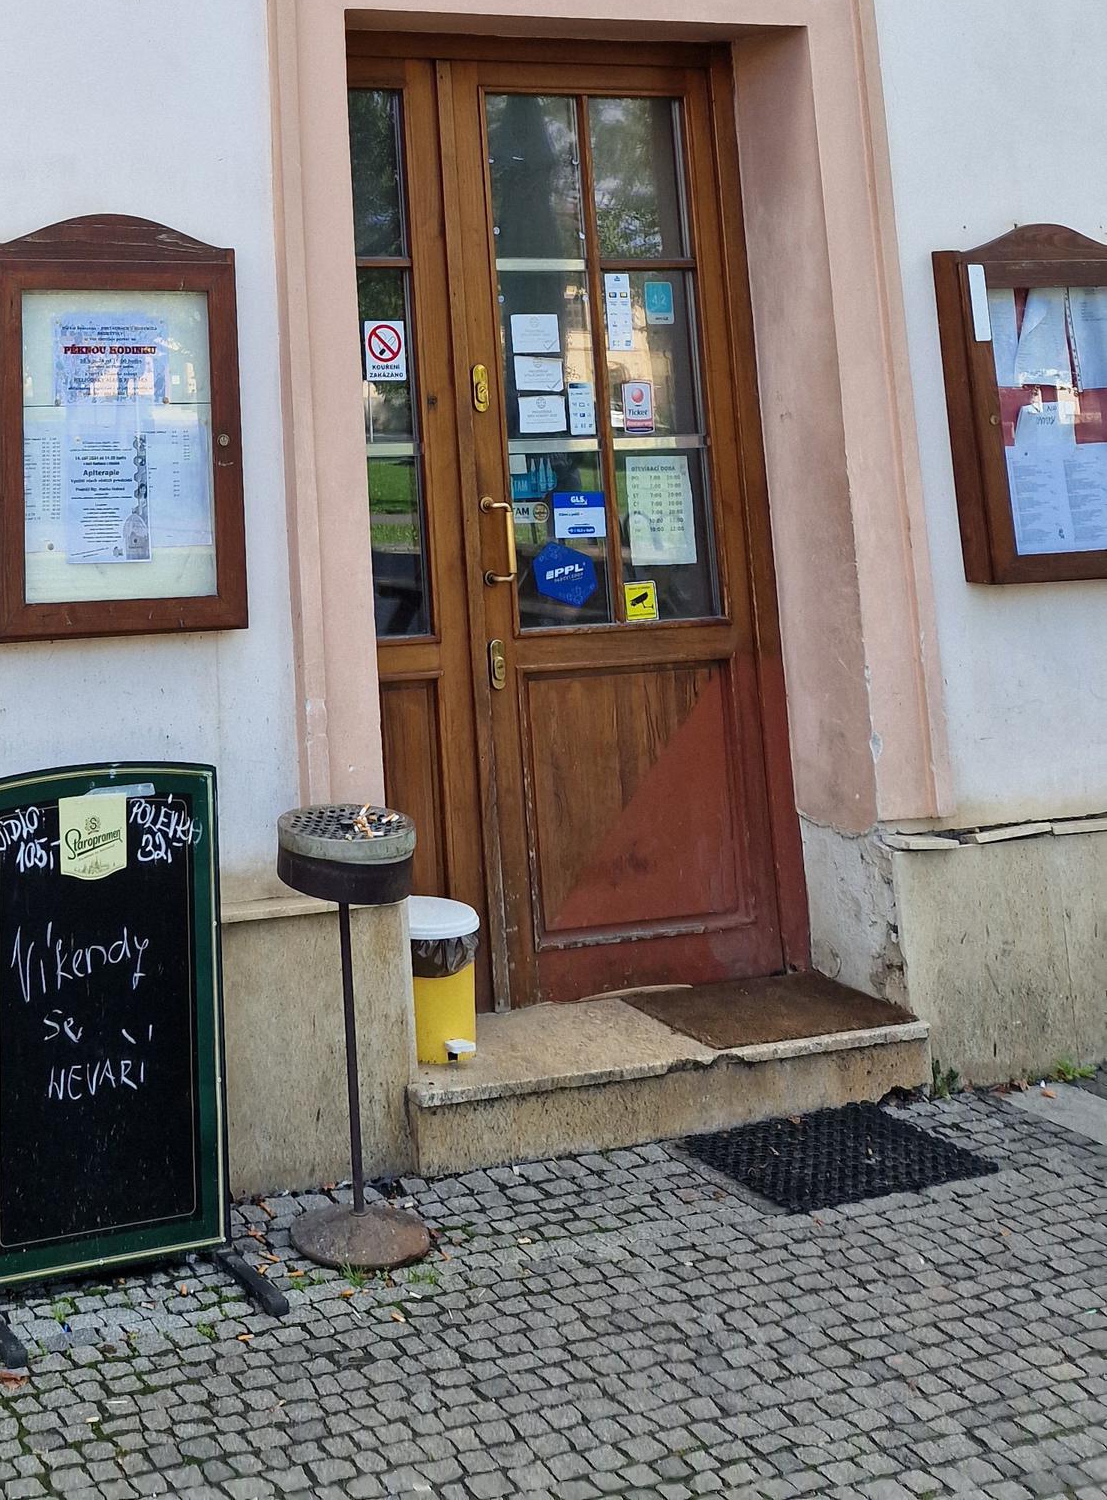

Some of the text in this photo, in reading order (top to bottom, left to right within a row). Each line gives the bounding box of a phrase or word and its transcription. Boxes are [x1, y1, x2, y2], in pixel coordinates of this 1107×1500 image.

[628, 408, 648, 417] Ticket
[570, 495, 586, 504] GLS
[555, 563, 584, 578] PPL
[65, 827, 123, 861] Staropramen
